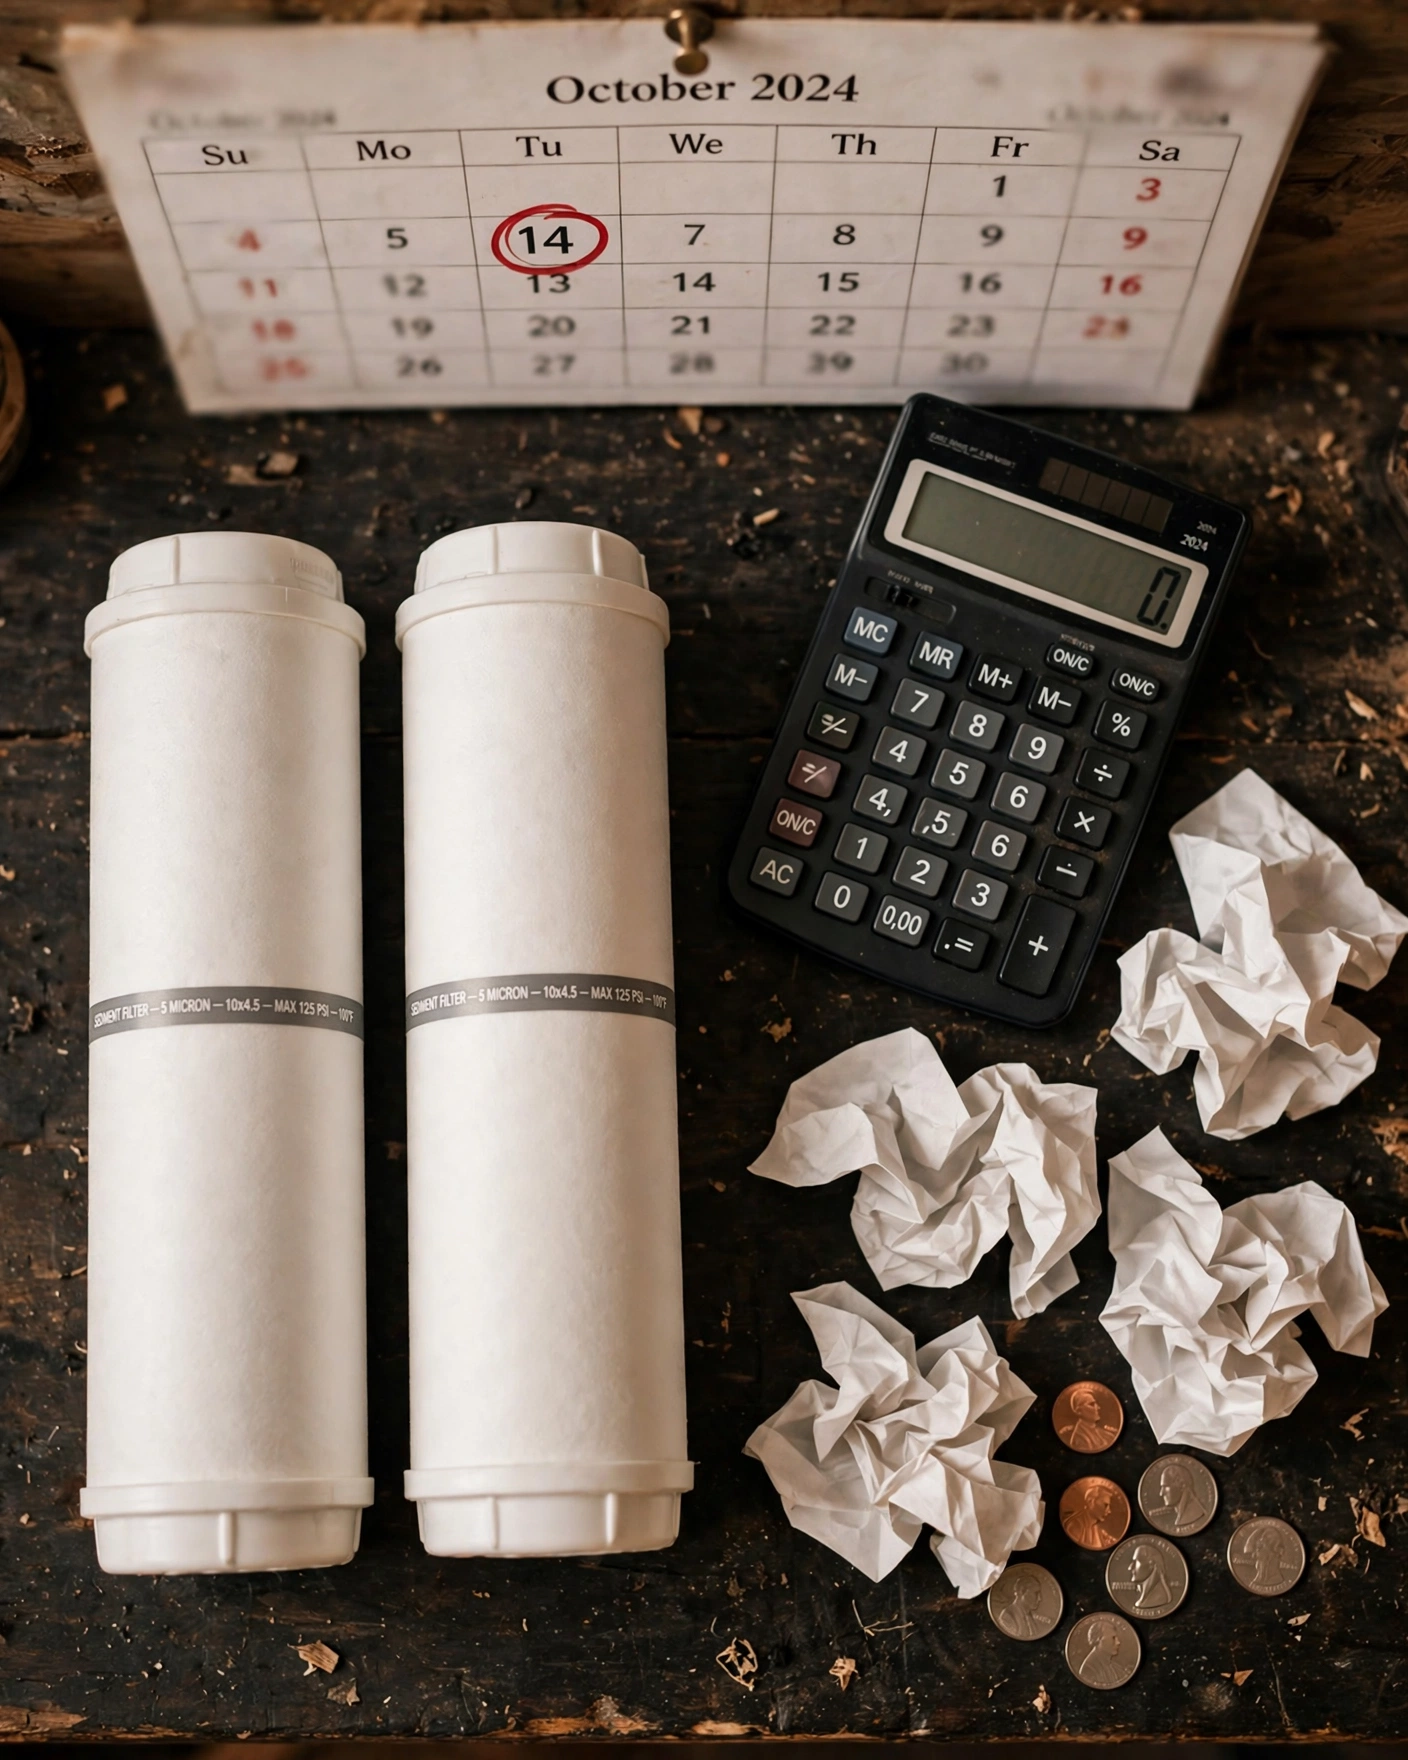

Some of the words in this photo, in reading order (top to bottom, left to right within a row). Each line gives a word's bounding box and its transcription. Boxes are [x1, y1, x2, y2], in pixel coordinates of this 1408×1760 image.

[546, 73, 736, 104] October
[751, 73, 859, 102] 2024
[201, 144, 249, 166] Su
[356, 140, 412, 161] Mo
[515, 135, 562, 157] Tu
[669, 133, 723, 154] We
[832, 133, 877, 155] Th
[991, 136, 1029, 158] Fr
[1139, 140, 1180, 161] Sa
[993, 175, 1006, 198] 1
[1136, 177, 1161, 202] 3
[387, 228, 408, 249] 5
[518, 226, 574, 254] 14
[684, 224, 706, 245] 7
[833, 224, 856, 245] 8
[980, 224, 1004, 247] 9
[1123, 227, 1148, 251] 9
[238, 277, 278, 299] 11
[383, 273, 426, 298] 12
[527, 274, 571, 293] 13
[673, 272, 716, 292] 14
[818, 272, 859, 292] 15
[960, 272, 1002, 295] 16
[1101, 274, 1143, 296] 16
[528, 315, 576, 338] 20
[671, 315, 710, 335] 21
[809, 315, 856, 336] 22
[1180, 533, 1208, 551] 2024
[853, 616, 888, 643] MC
[919, 642, 954, 669] MR
[1053, 648, 1090, 671] ON/C
[978, 663, 1013, 690] M+
[1119, 673, 1155, 696] ON/C
[910, 690, 929, 713] 7
[968, 714, 988, 738] 8
[1112, 712, 1131, 737] %
[889, 740, 908, 763] 4
[1028, 736, 1047, 760] 9
[949, 762, 969, 785] 5
[1009, 785, 1029, 809] 6
[776, 809, 816, 836] ON/C
[855, 837, 869, 860] 1
[991, 834, 1011, 858] 6
[759, 859, 794, 884] AC
[910, 860, 930, 884] 2
[833, 884, 852, 909] 0
[970, 882, 990, 907] 3
[478, 989, 485, 1002] 5
[487, 986, 529, 1001] MICRON
[543, 985, 577, 999] 10x4.5
[591, 986, 613, 1000] MAX
[615, 988, 631, 1002] 125
[632, 990, 644, 1004] PSI
[160, 1002, 168, 1015] 5
[169, 998, 211, 1013] MICRON
[225, 998, 261, 1012] 10x4.5
[274, 999, 297, 1014] MAX
[299, 1001, 315, 1016] 125
[316, 1004, 330, 1018] PSI
